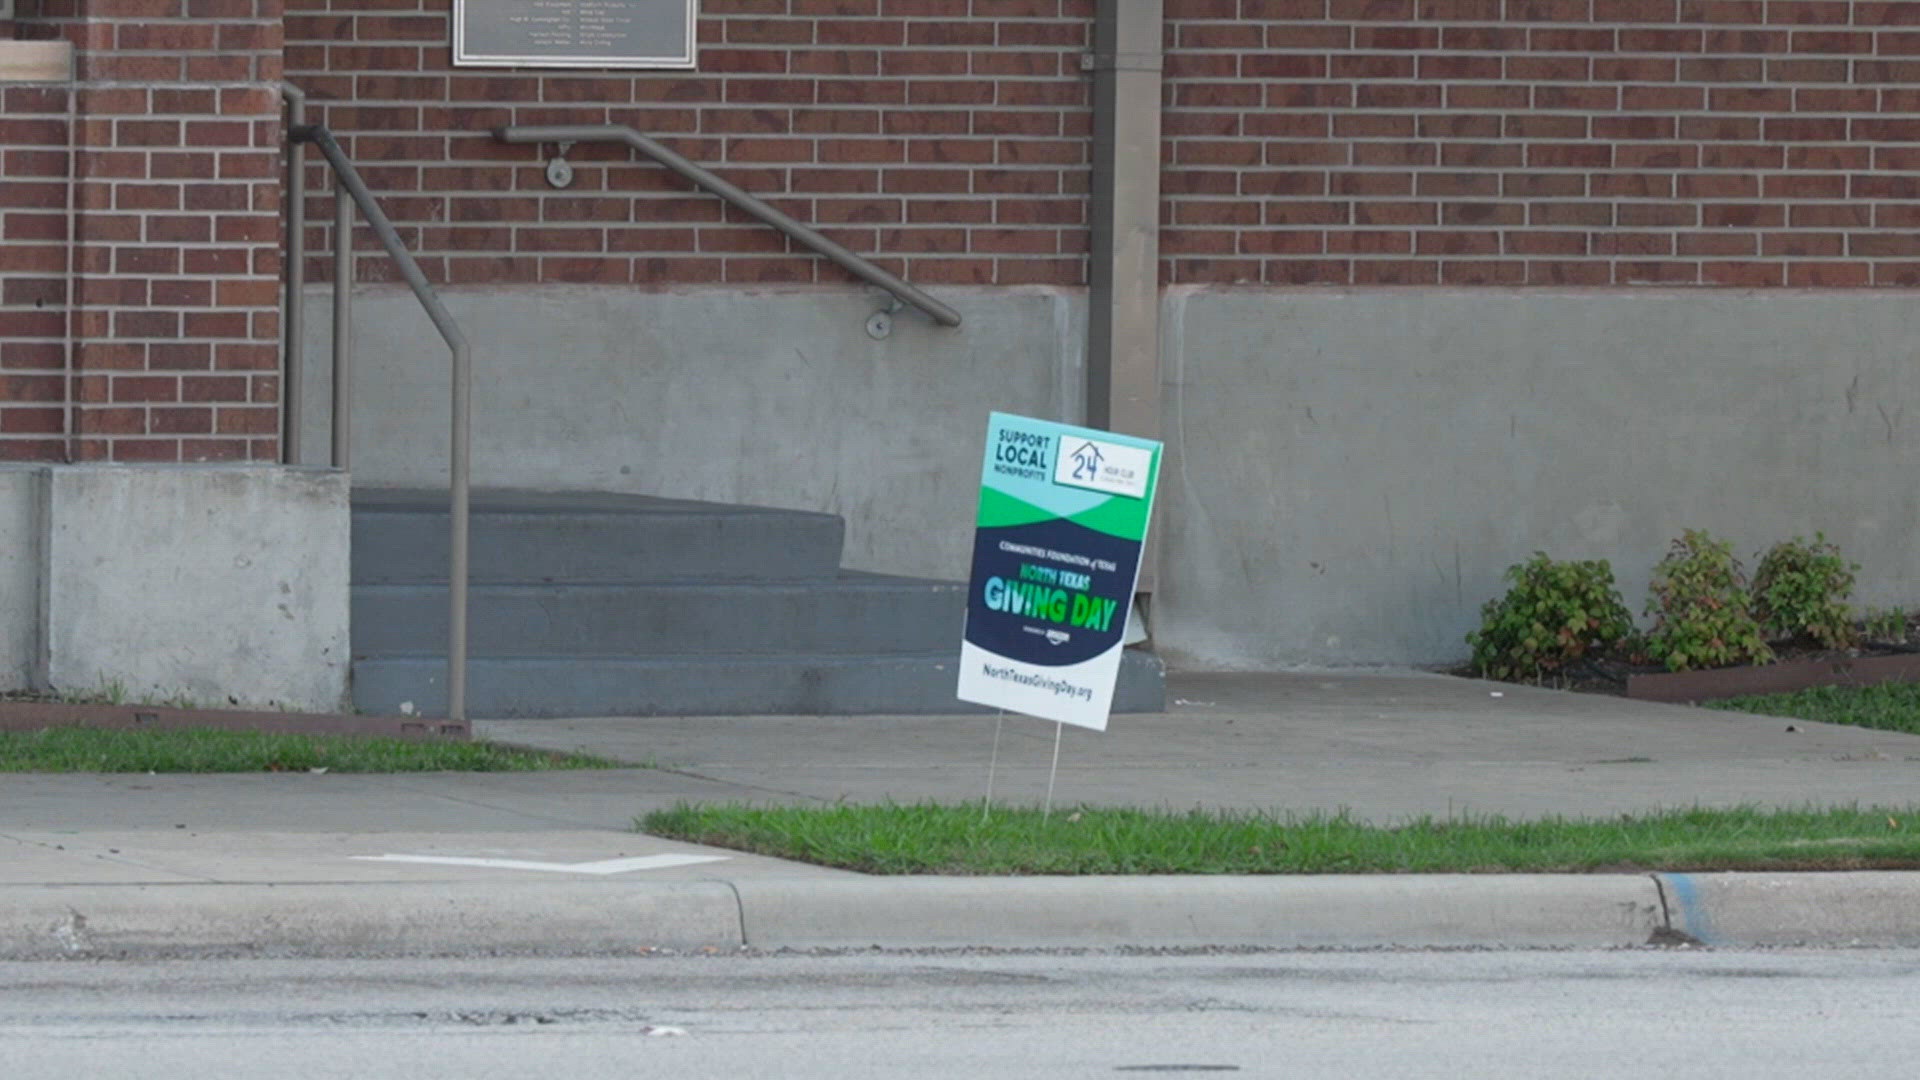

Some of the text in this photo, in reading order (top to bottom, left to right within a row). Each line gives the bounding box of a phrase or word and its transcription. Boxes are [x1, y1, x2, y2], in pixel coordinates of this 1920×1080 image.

[999, 428, 1050, 449] SUPPORT
[996, 443, 1047, 469] LOCAL
[1072, 453, 1098, 481] 24
[994, 463, 1046, 482] NONPROFITS
[1020, 562, 1092, 591] NORTH TEXAS
[984, 575, 1118, 632] GIVING DAY
[982, 663, 1093, 702] NorthTexasGivingDay.org
